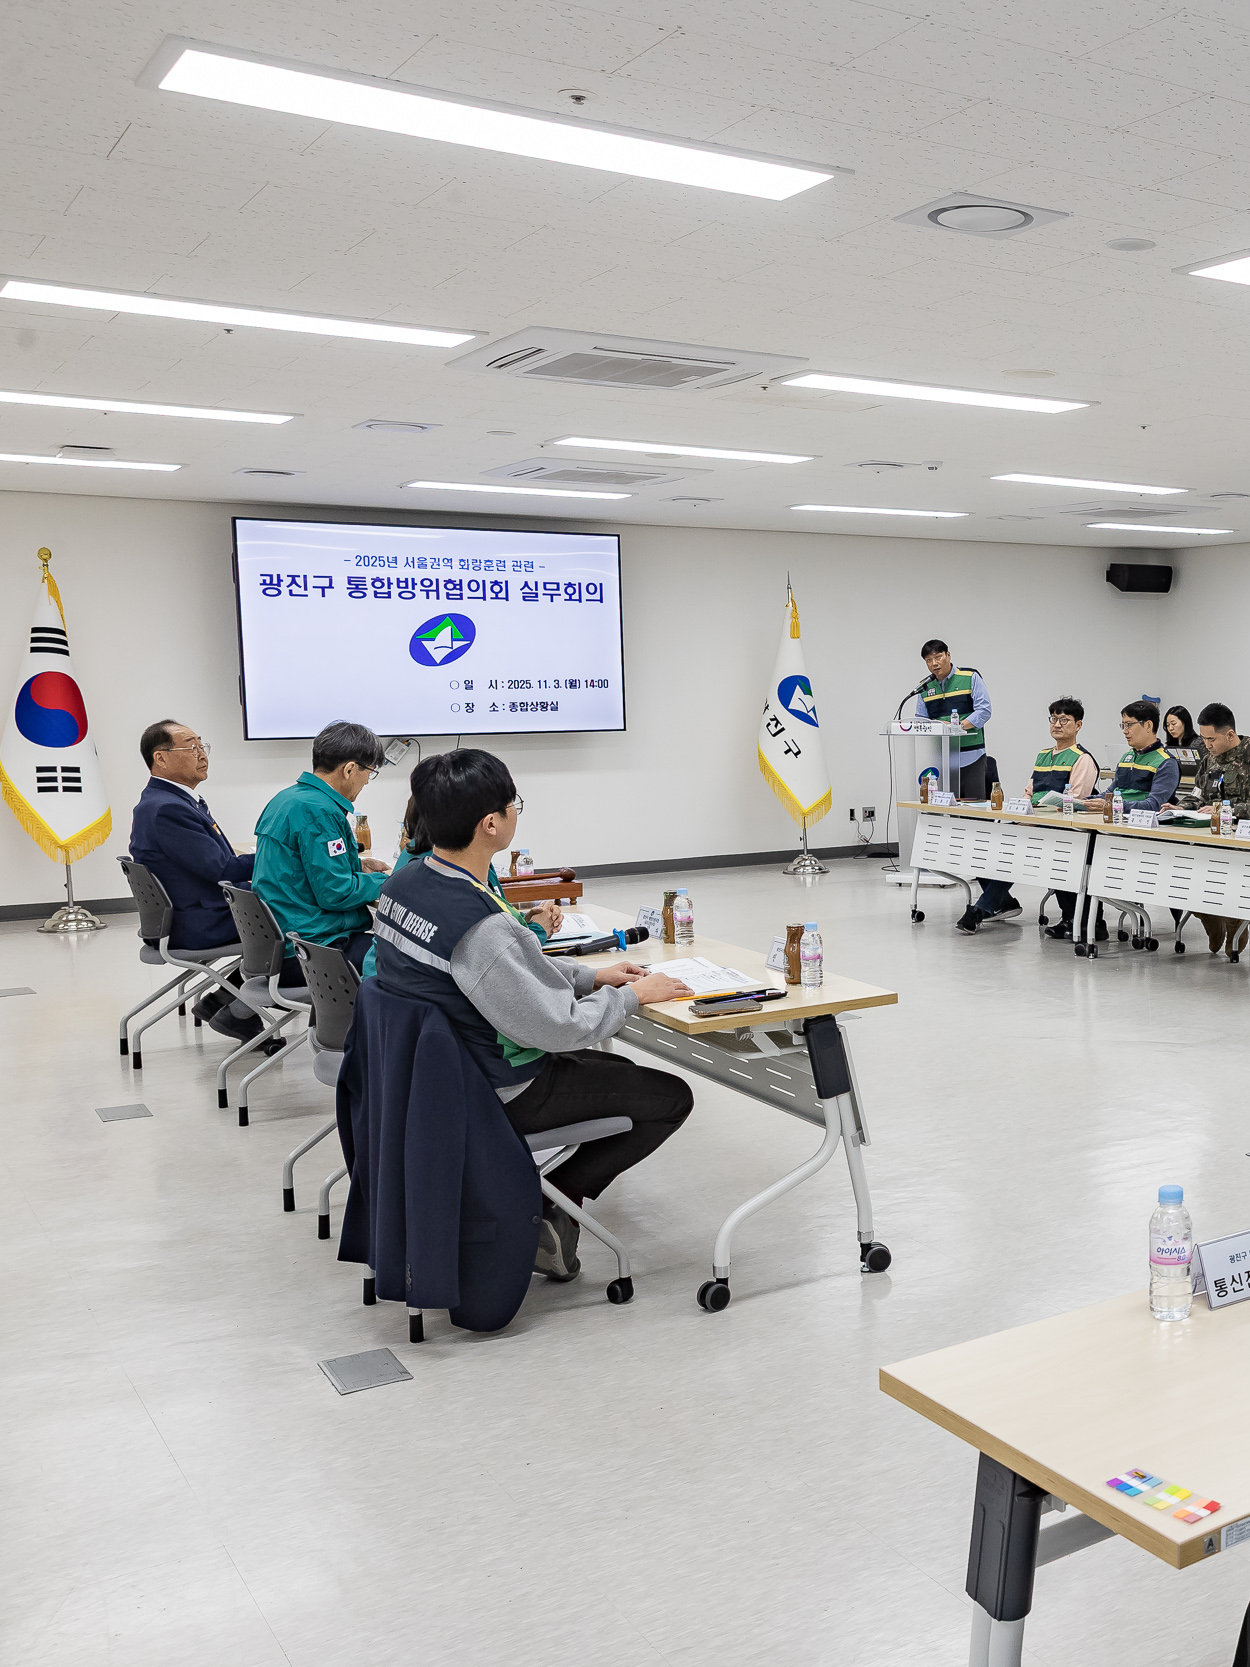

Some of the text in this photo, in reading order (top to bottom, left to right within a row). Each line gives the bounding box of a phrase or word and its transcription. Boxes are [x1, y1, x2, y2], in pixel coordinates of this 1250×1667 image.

[355, 555, 398, 568] 2025년
[403, 556, 453, 570] 서울권역
[458, 558, 507, 572] 화랑훈련
[511, 560, 534, 573] 관련
[259, 573, 604, 604] 광진구 통합방위협의회 실무회의
[463, 679, 474, 690] 일
[488, 679, 498, 690] 시
[507, 679, 534, 690] 2025.
[537, 679, 551, 690] 11.
[584, 679, 609, 689] 14:00
[464, 702, 475, 713] 장
[489, 702, 499, 713] 소
[508, 701, 559, 713] 종합상황실
[401, 911, 439, 943] DEFENSE
[1156, 1246, 1187, 1256] 아이시스
[1229, 1251, 1248, 1264] 광진구
